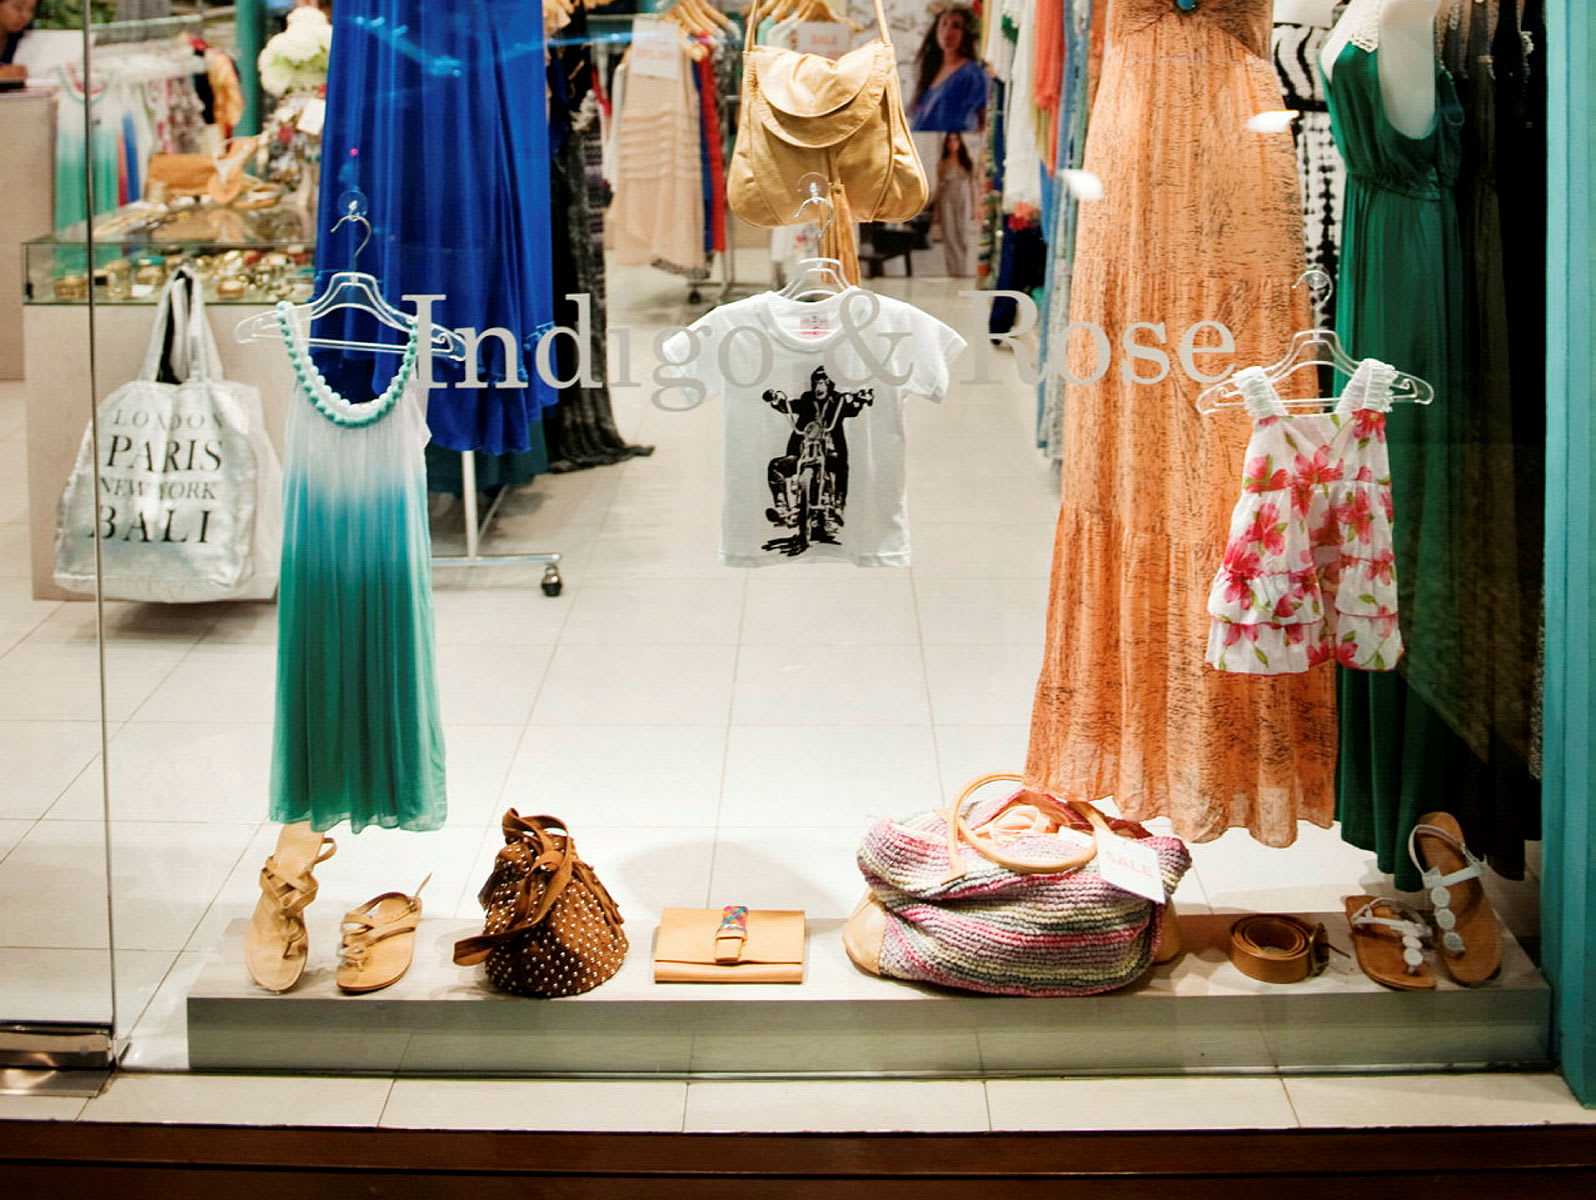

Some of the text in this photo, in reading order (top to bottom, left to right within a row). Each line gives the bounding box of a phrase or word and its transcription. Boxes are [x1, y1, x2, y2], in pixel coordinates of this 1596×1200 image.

[402, 289, 1236, 412] Indigo & Rose
[112, 408, 226, 432] LONDON
[106, 434, 224, 474] PARIS
[98, 476, 145, 497] NEW
[87, 504, 213, 544] BALI
